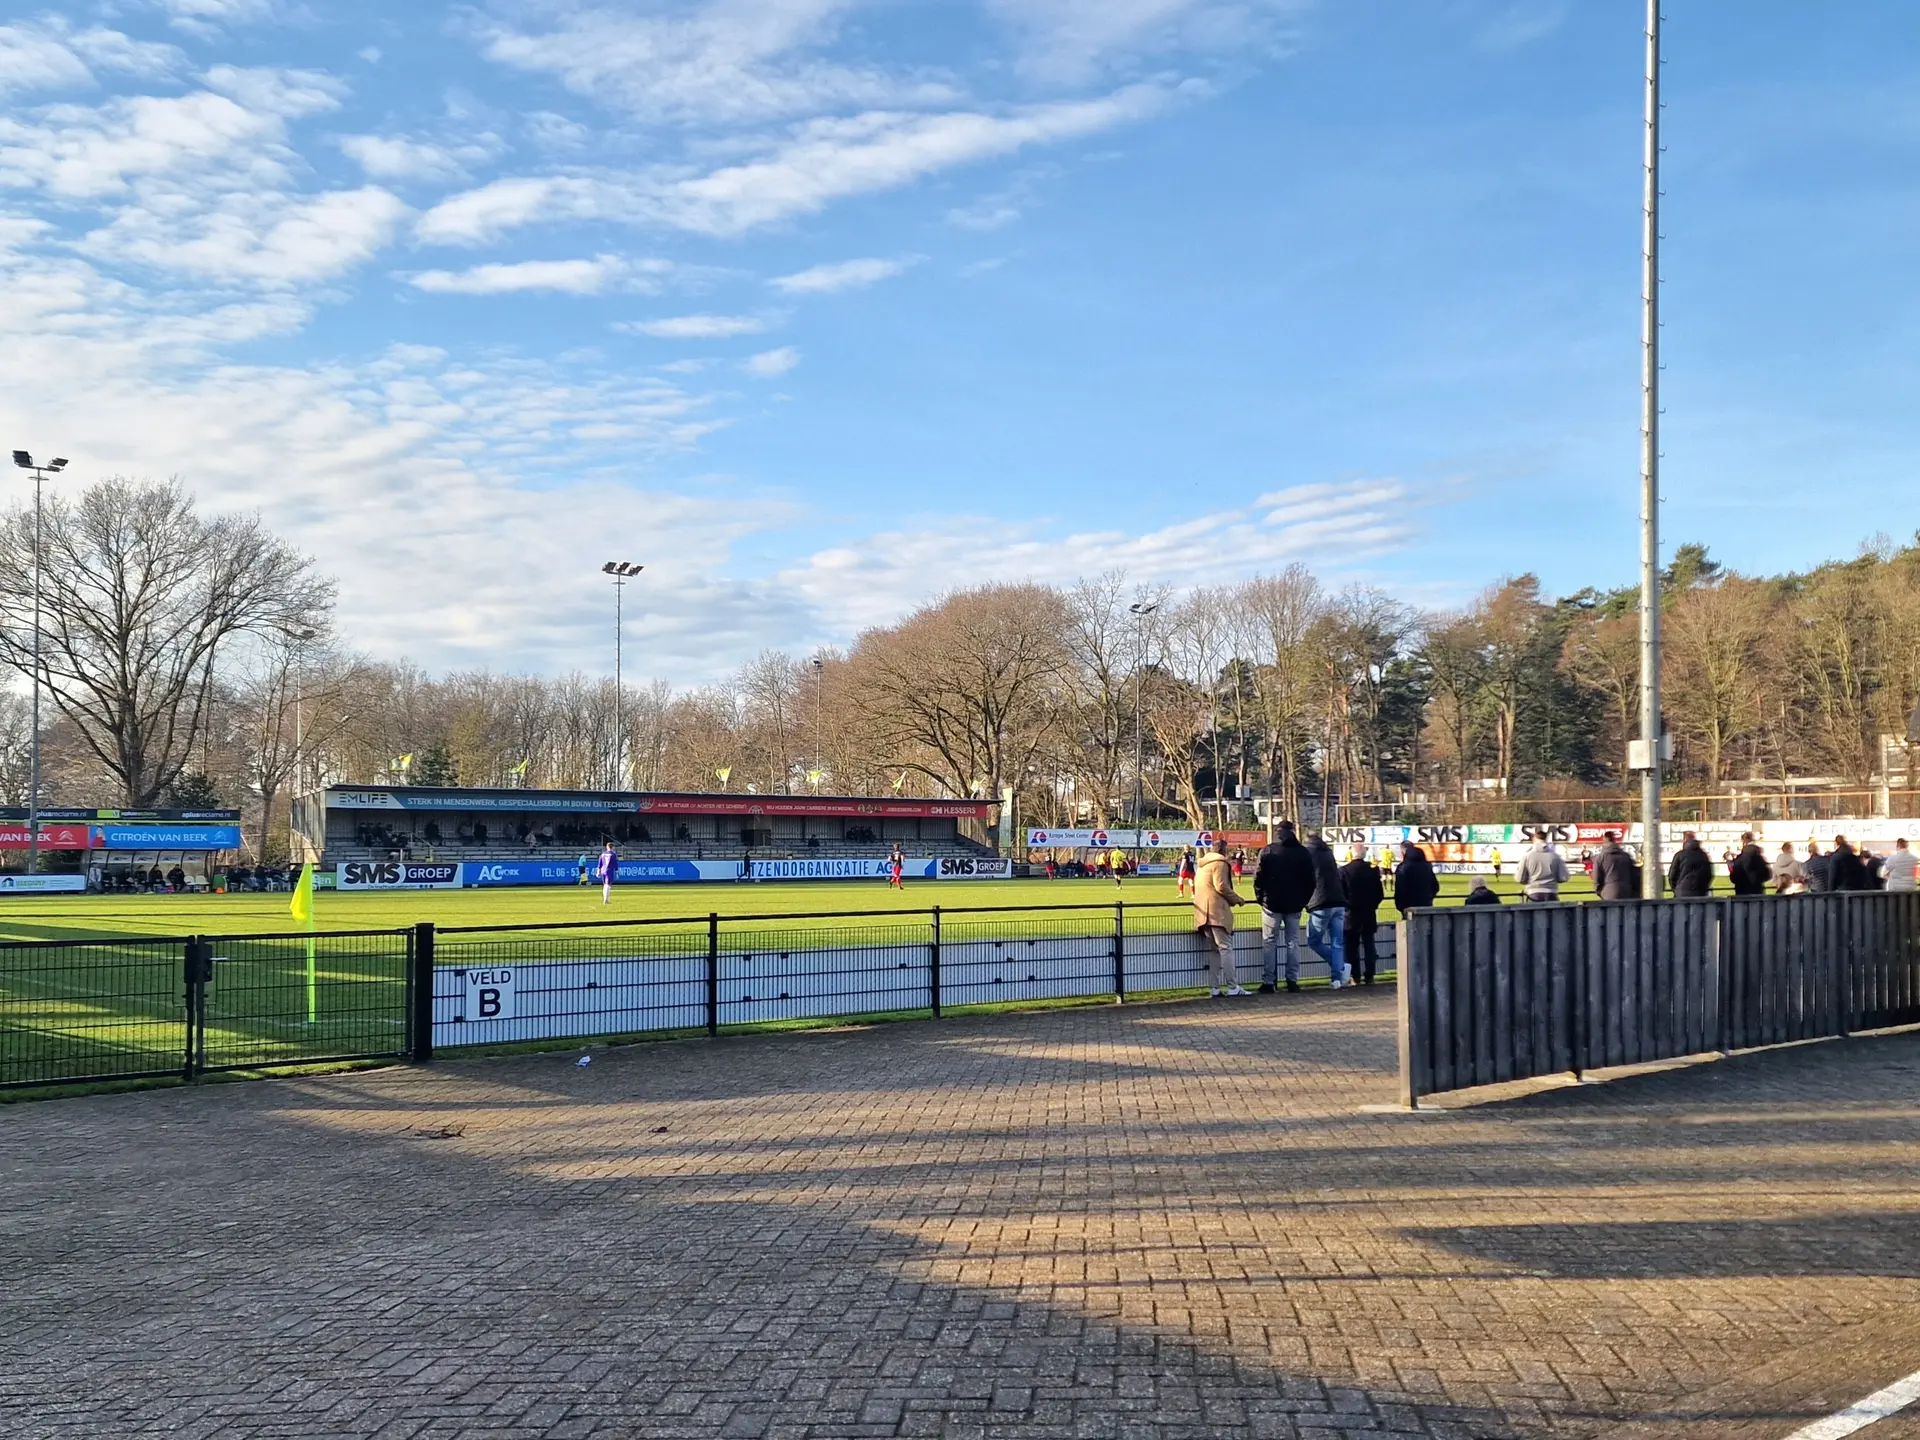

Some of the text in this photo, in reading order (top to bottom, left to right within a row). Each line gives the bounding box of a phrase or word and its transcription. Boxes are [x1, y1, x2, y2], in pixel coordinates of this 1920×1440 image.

[339, 793, 388, 804] EMLIFE
[444, 798, 498, 807] MENSENWERK,
[499, 799, 561, 807] GESPECIALISEERD
[571, 800, 592, 808] BOUW
[593, 800, 602, 808] EN
[36, 811, 87, 820] plusreclame.nl
[181, 811, 231, 819] aplusreclame.nl
[24, 832, 52, 841] BEK
[158, 834, 181, 842] VAN
[184, 833, 208, 842] BEEK
[1325, 828, 1365, 843] SMS
[1417, 826, 1463, 842] SMS
[541, 868, 555, 877] TEL:
[556, 868, 565, 877] 06
[618, 866, 676, 877] NFO@AC-WORK.NL
[736, 861, 869, 877] UTZENDORGANISATIE
[941, 858, 1005, 876] SMS GROEP
[344, 863, 400, 884] SMS
[407, 867, 451, 879] GROEP
[470, 970, 512, 986] VELD
[479, 988, 502, 1018] B
